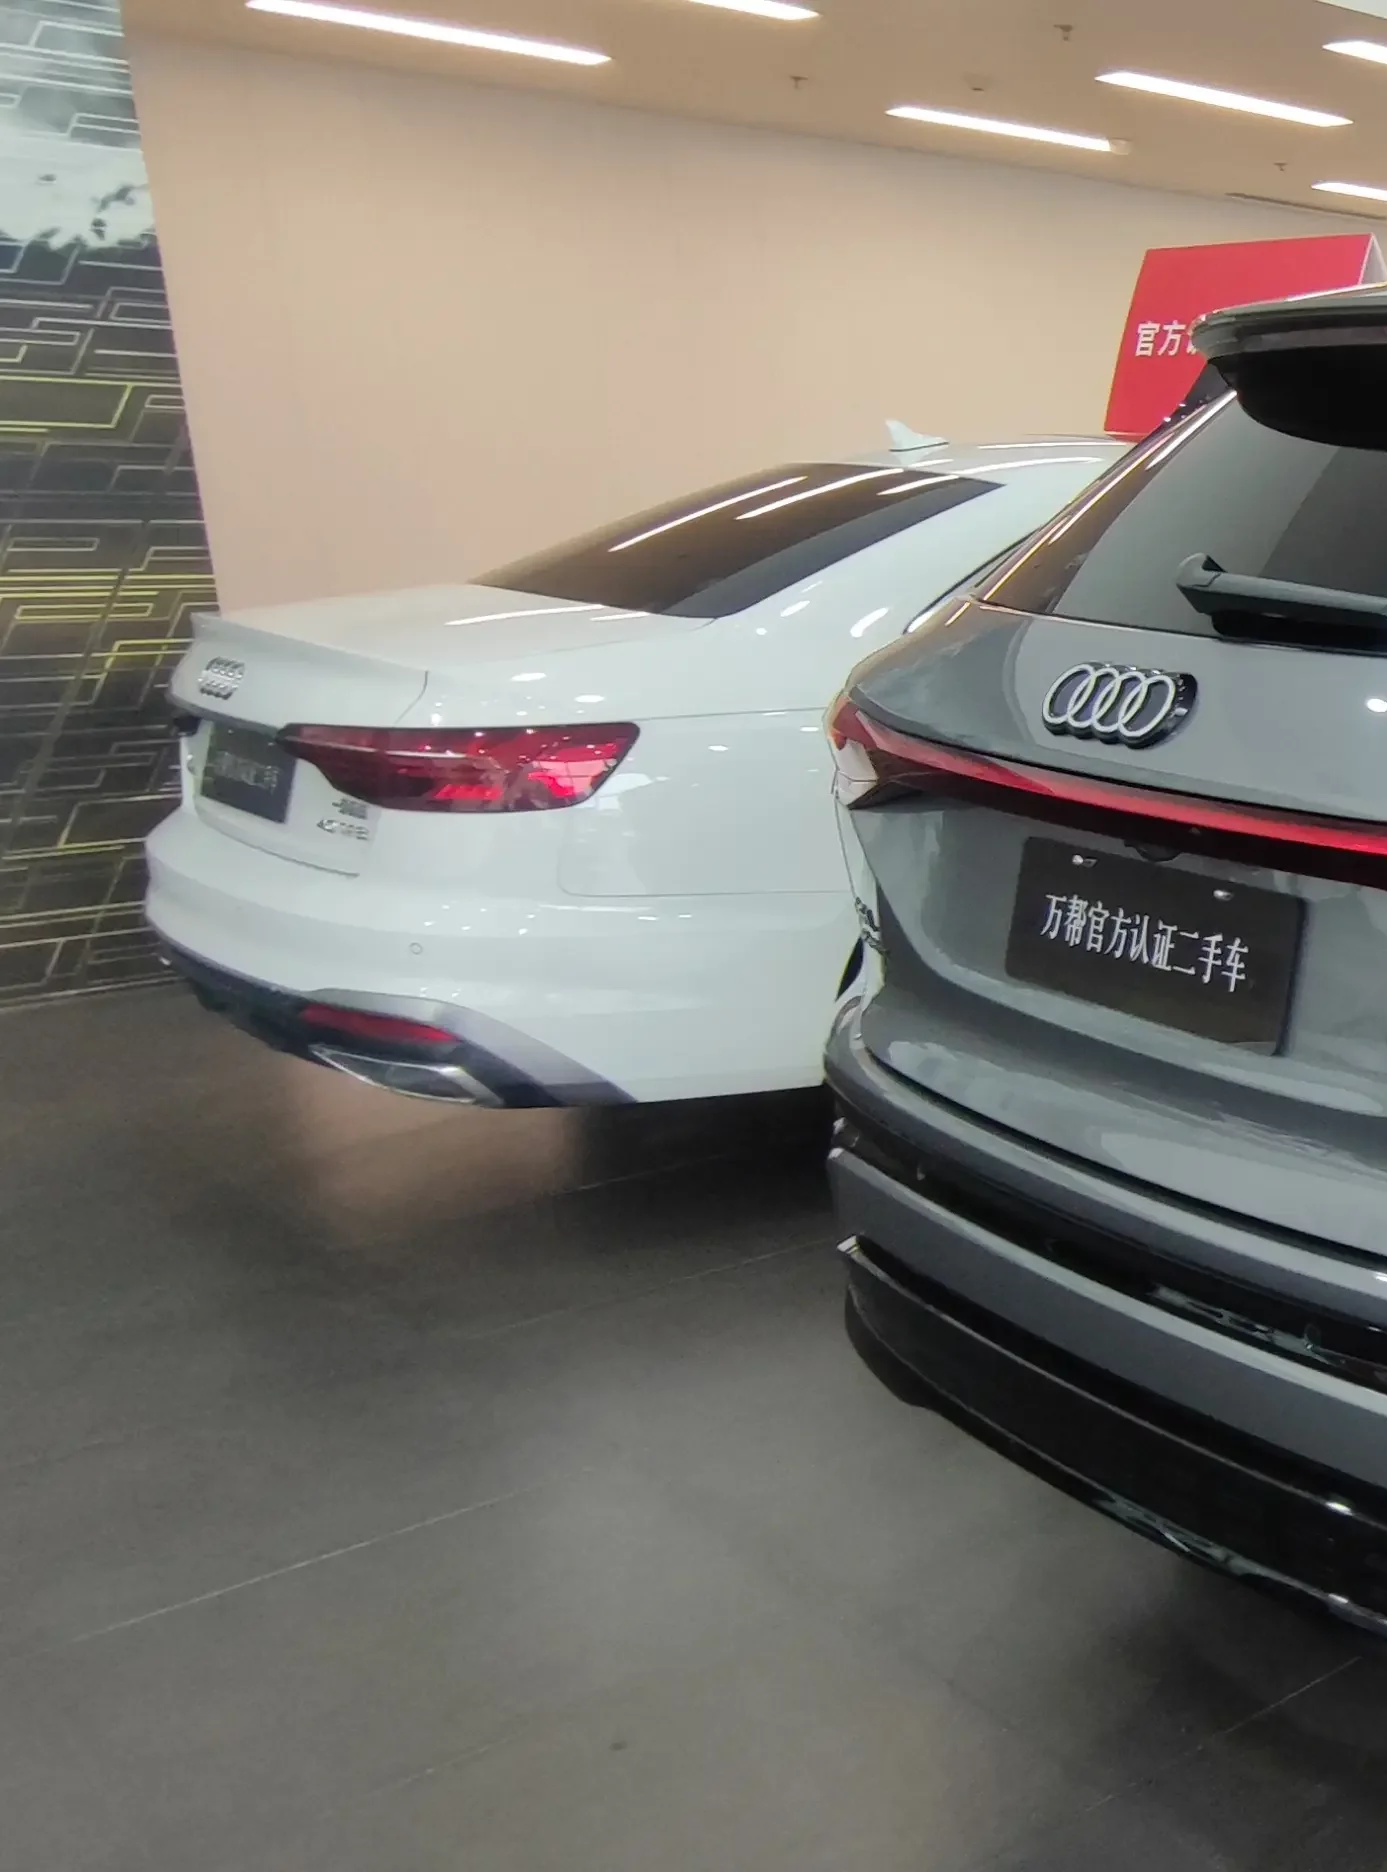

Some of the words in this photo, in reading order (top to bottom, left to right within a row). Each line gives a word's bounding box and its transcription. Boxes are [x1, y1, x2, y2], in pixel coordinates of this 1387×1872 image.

[1040, 894, 1249, 993] 万帮官方认证二手车
